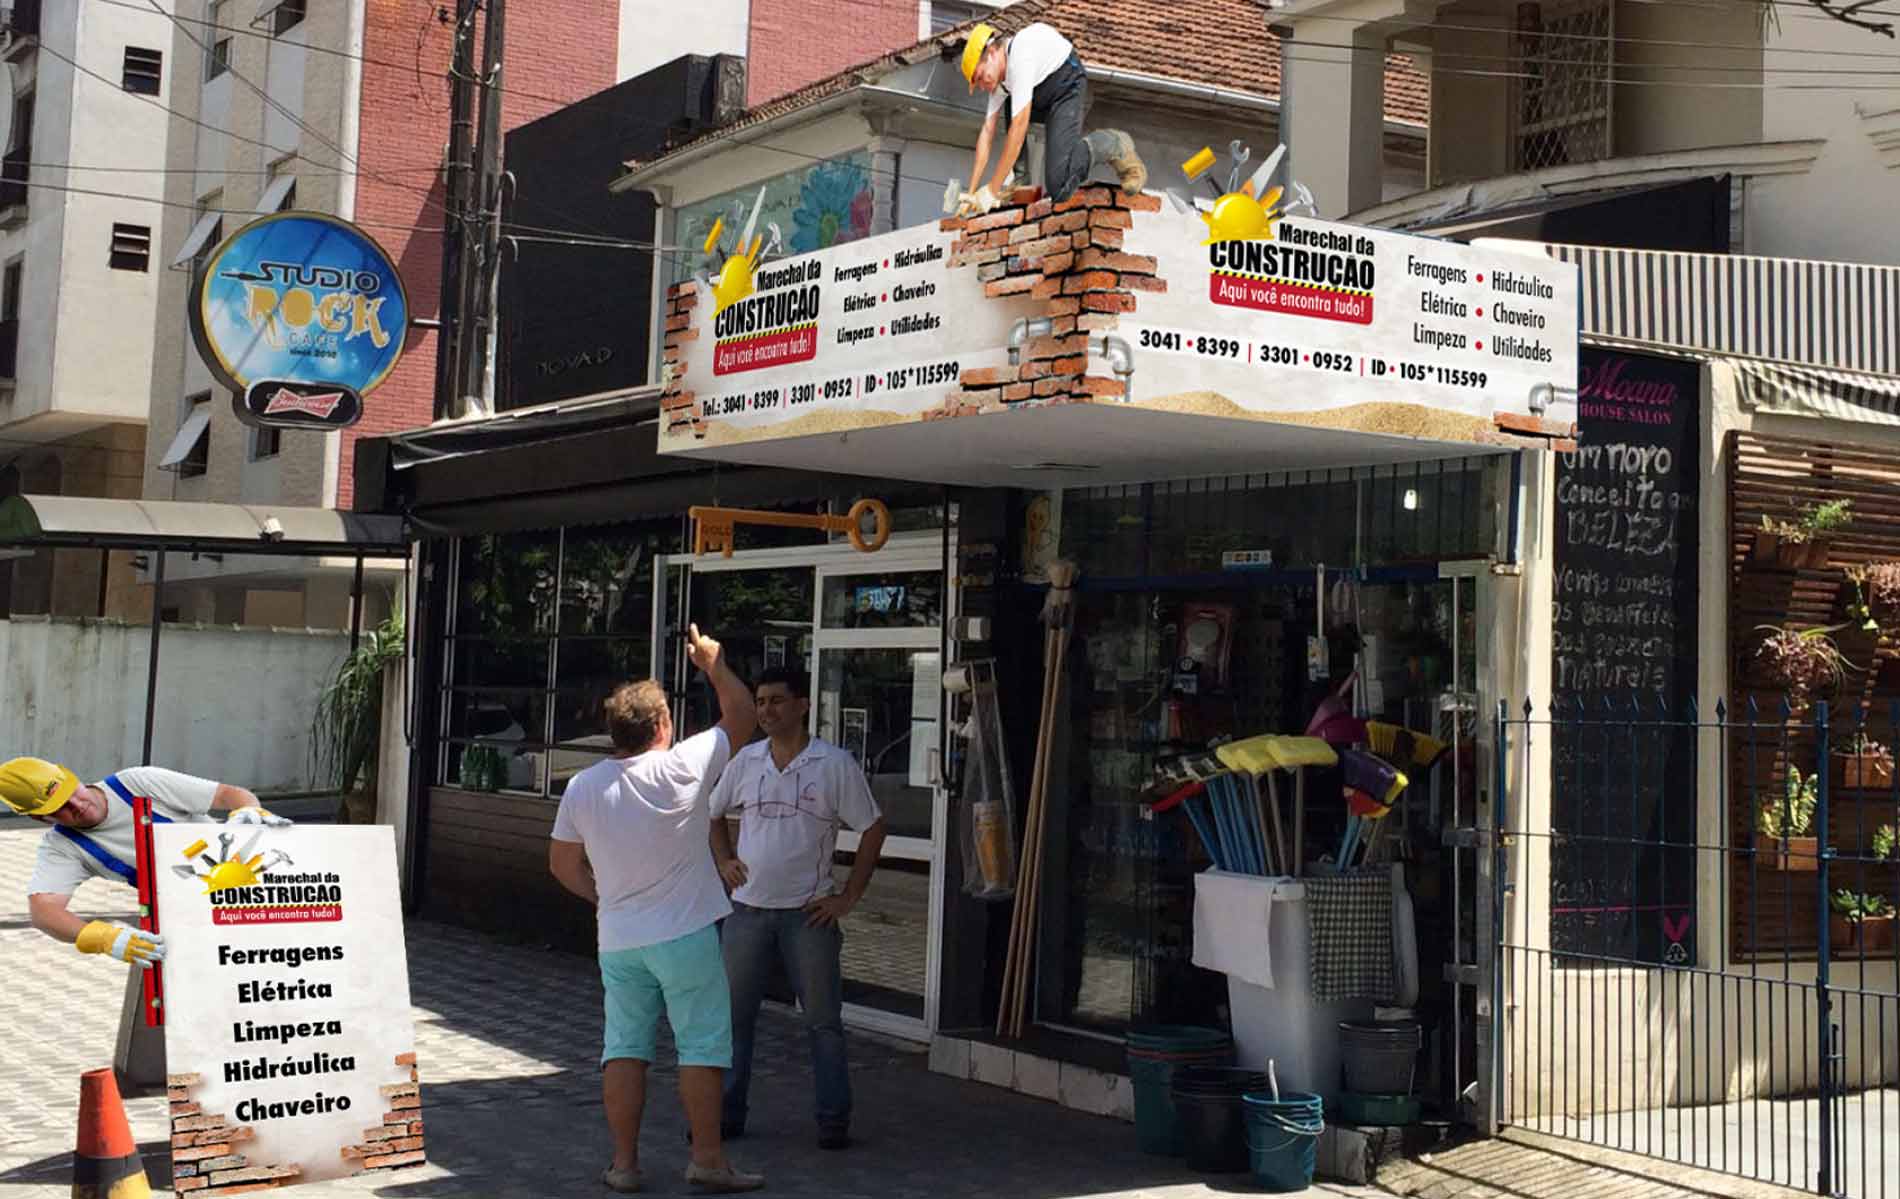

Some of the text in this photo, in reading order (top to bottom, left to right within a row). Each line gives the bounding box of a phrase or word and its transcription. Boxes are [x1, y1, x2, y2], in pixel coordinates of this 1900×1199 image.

[1279, 223, 1375, 256] Marechal da
[243, 261, 380, 293] STUDIO
[757, 259, 821, 292] Marechal da
[834, 244, 943, 282] Ferragens Hidráulica
[1407, 254, 1553, 299] Ferragens Hidráulica
[844, 280, 936, 313] Elétrica Chaveiro
[1219, 279, 1365, 317] Aqui você encontra tudo!
[1421, 291, 1546, 329] Elétrica Chaveiro
[245, 287, 390, 350] ROCK
[837, 312, 941, 346] Limpeza Utilidades
[1139, 329, 1181, 351] 3041
[1196, 336, 1240, 358] 8399
[1260, 345, 1298, 366] 3301
[1313, 351, 1352, 373] 0952
[1371, 359, 1386, 376] ID
[1413, 322, 1553, 363] Limpeza Utilidades
[263, 872, 340, 884] Marechal da
[220, 910, 242, 924] Aqui
[245, 910, 266, 921] você
[268, 909, 308, 920] encontra
[218, 945, 344, 968] Ferragens
[238, 978, 333, 1003] Elétrica
[233, 1020, 342, 1044] Limpeza
[223, 1052, 356, 1083] Hidráulica
[235, 1092, 351, 1122] Chaveiro
